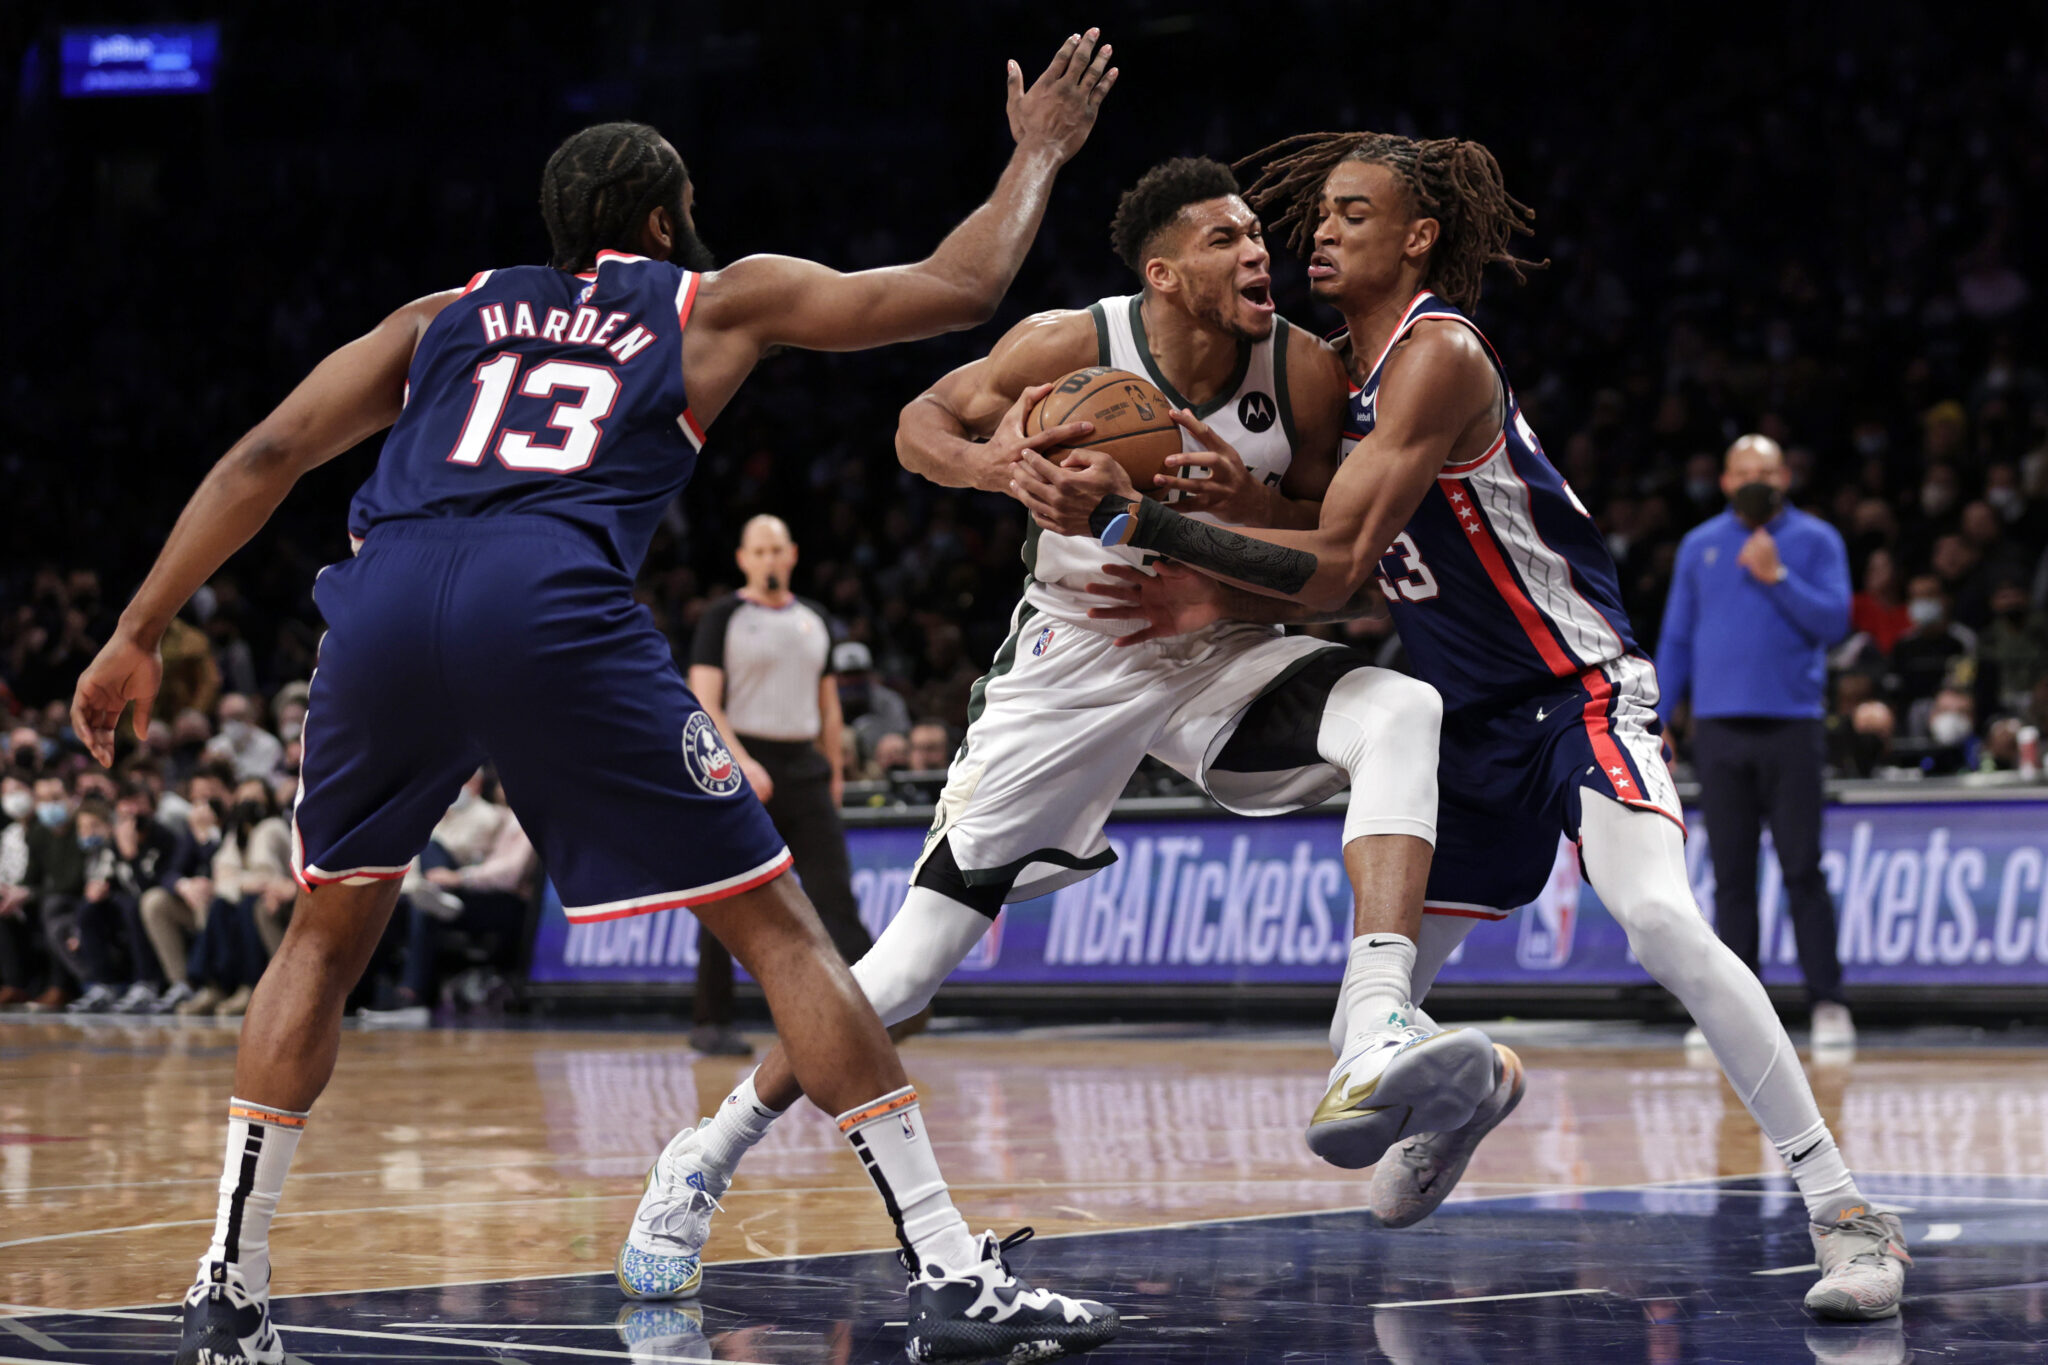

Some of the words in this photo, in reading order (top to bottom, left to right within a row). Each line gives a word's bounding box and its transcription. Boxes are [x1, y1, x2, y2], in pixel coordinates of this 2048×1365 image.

[479, 301, 658, 365] HARDEN
[446, 351, 623, 474] 13
[699, 747, 732, 776] Nets
[701, 775, 726, 792] NEW
[1043, 833, 1354, 965] NBATickets.
